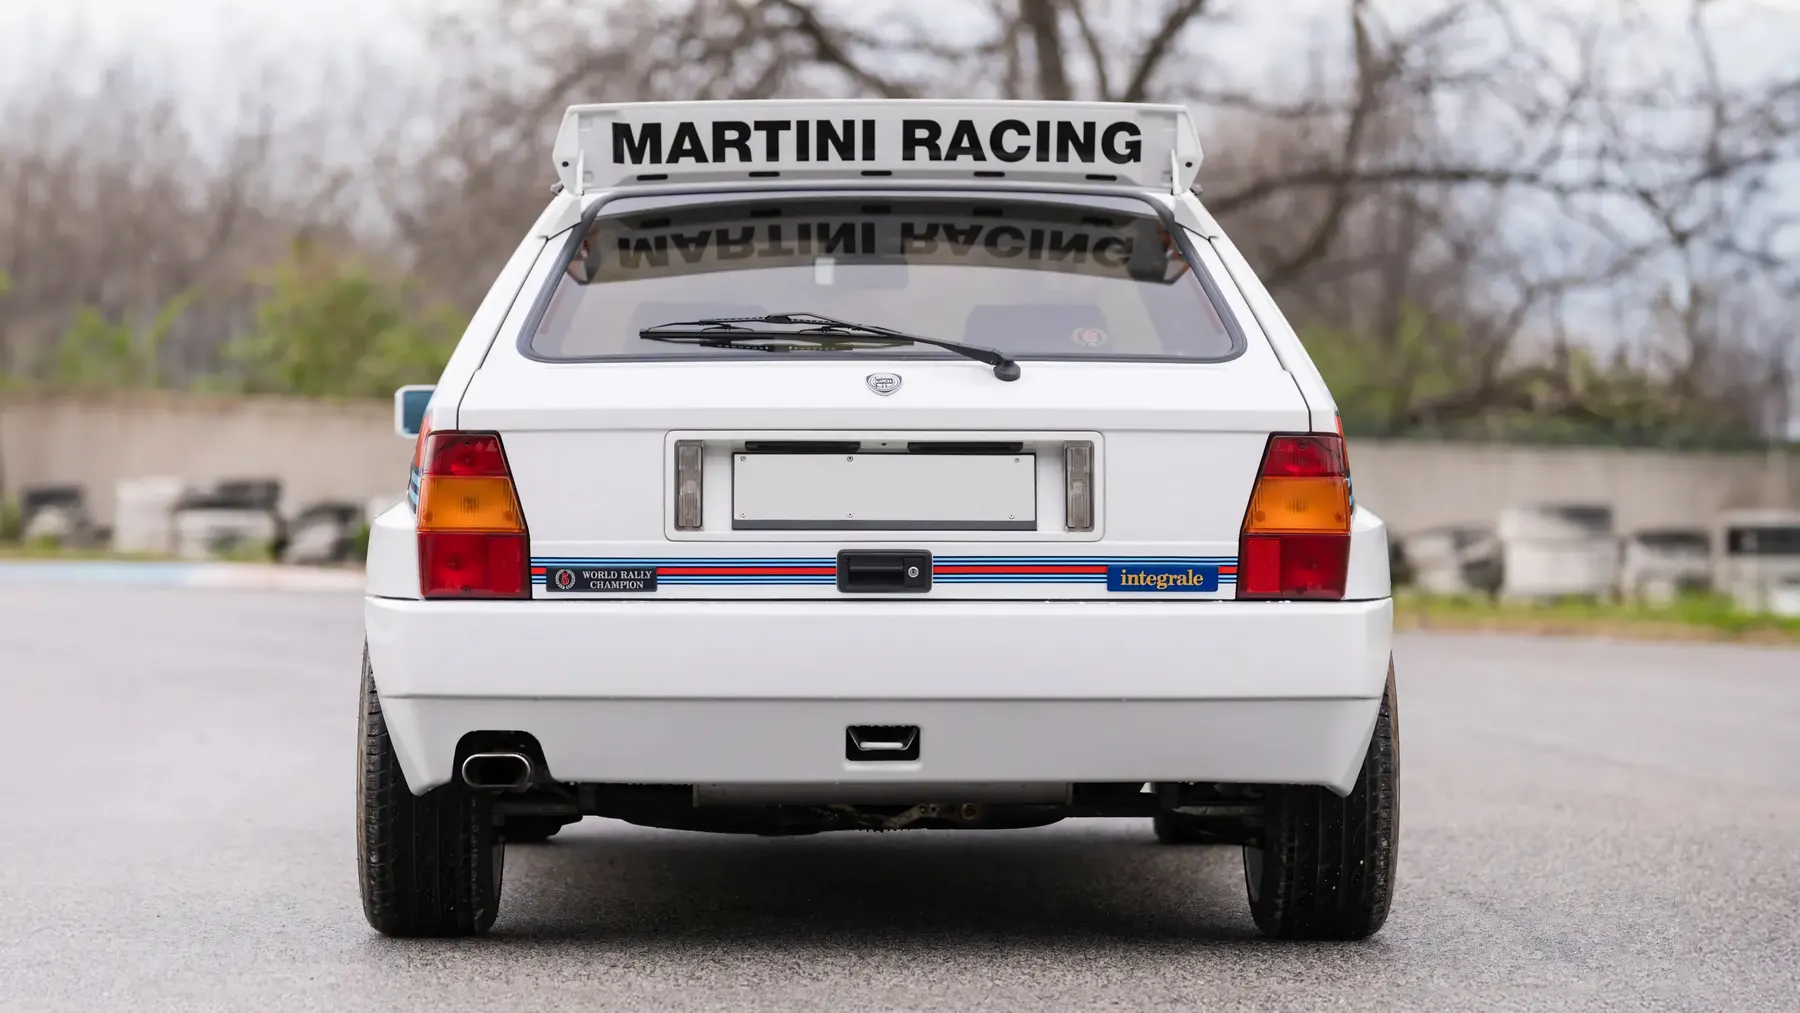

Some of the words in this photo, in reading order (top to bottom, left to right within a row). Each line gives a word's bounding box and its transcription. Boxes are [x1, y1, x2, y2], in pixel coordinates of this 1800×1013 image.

[612, 119, 876, 165] MARTINI
[902, 119, 1143, 164] RACING
[582, 570, 618, 579] WORLD
[620, 570, 652, 579] RALLY
[1120, 569, 1204, 590] integrale
[589, 580, 644, 589] CHAMPION
